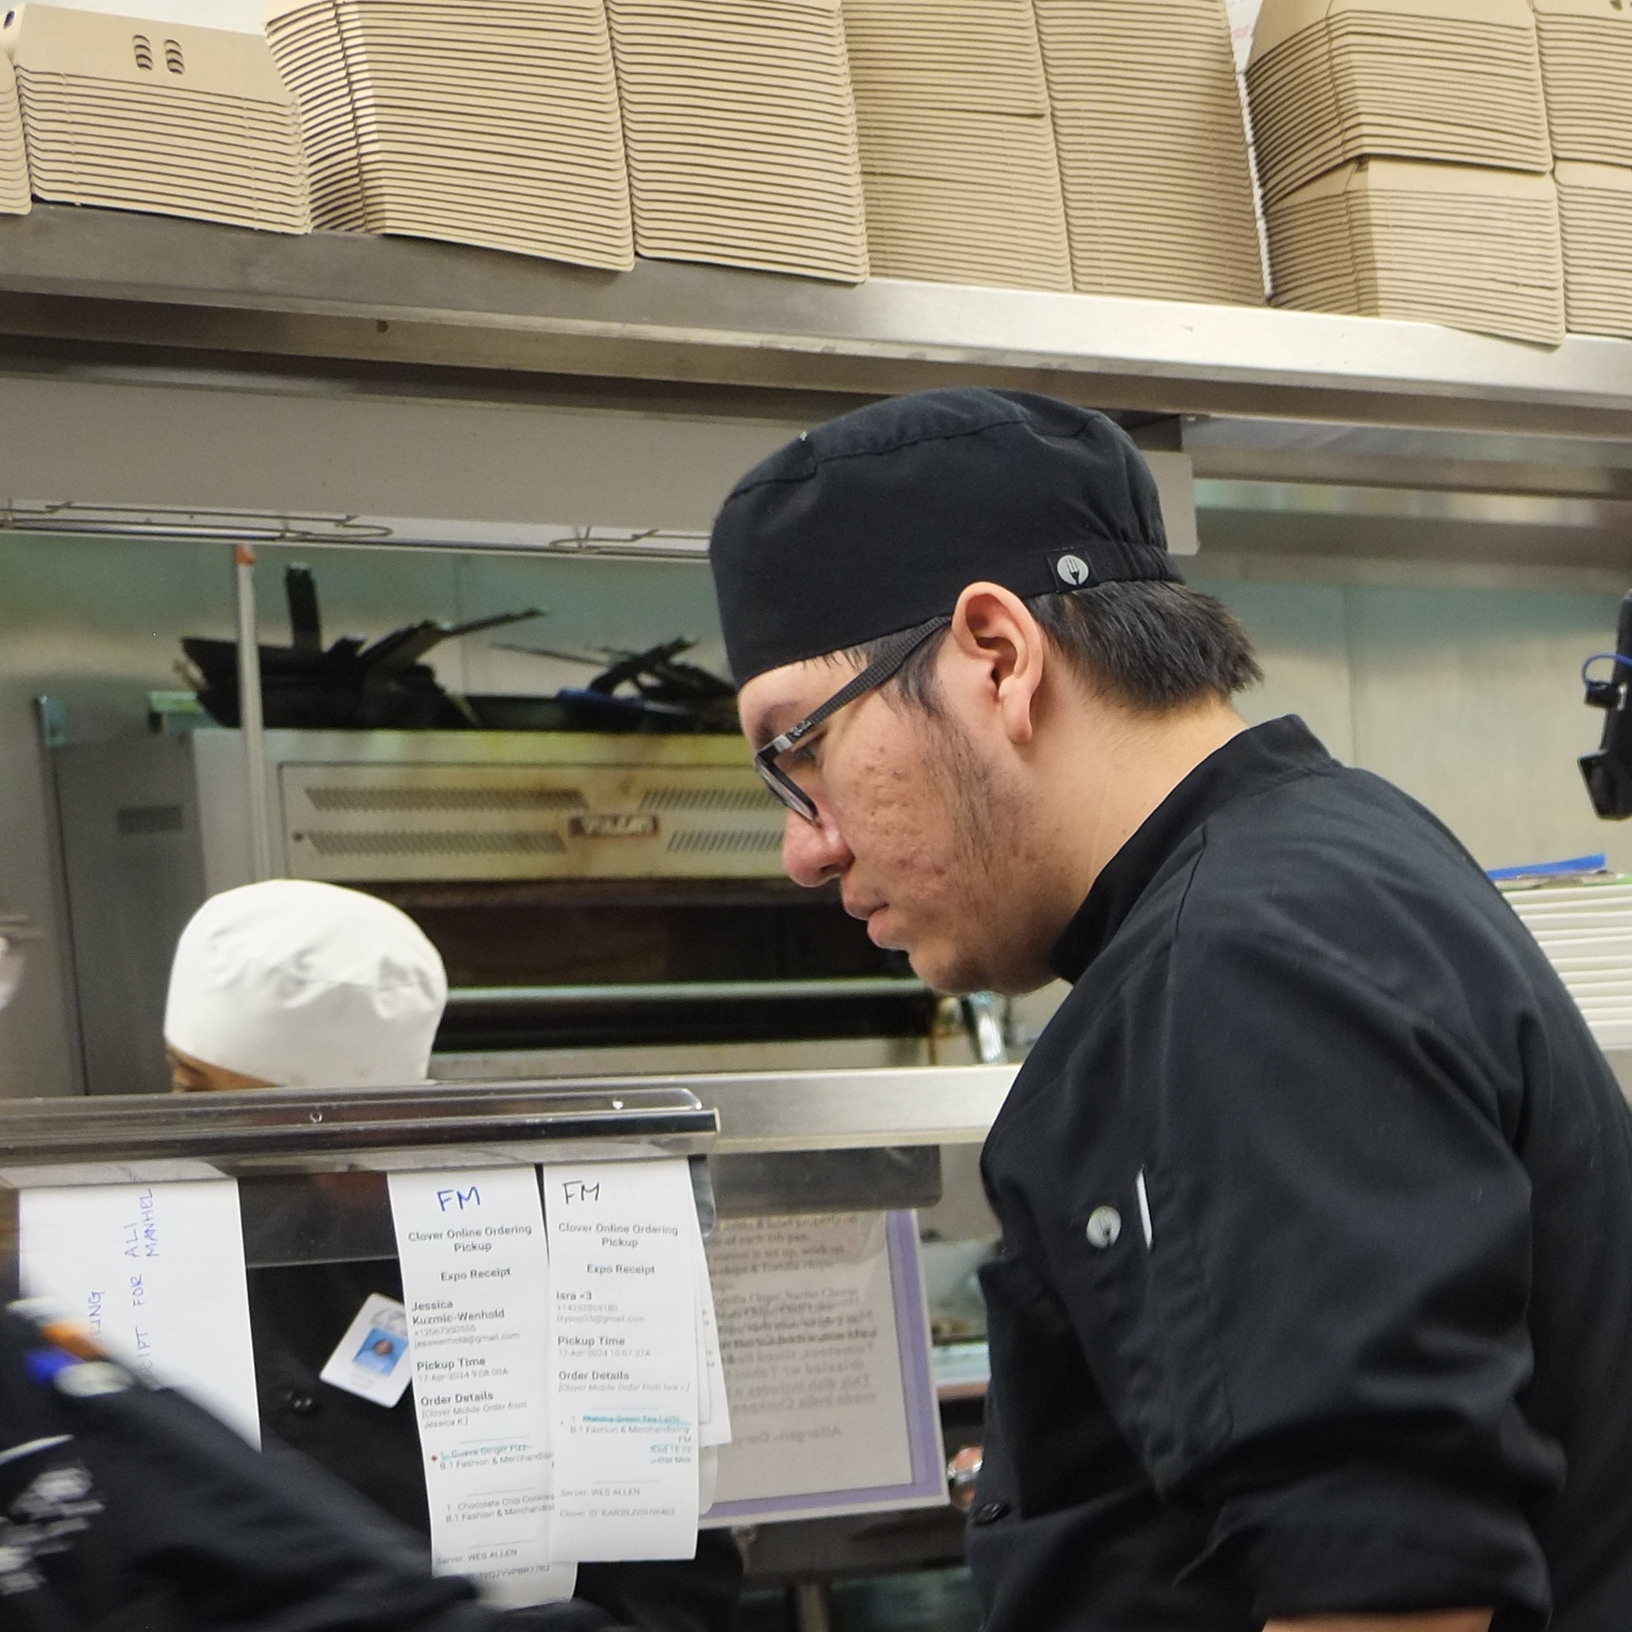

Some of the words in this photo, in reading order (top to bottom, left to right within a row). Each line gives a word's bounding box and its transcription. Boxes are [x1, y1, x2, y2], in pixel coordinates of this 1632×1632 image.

[437, 1186, 480, 1211] FM
[562, 1180, 600, 1204] FM
[408, 1231, 443, 1242] Clover
[447, 1229, 481, 1239] Online
[485, 1225, 532, 1236] Ordering
[558, 1223, 592, 1233] Clover
[595, 1223, 629, 1233] Online
[632, 1224, 678, 1236] Ordering
[124, 1223, 140, 1257] ALI
[602, 1237, 638, 1248] Pickup
[454, 1242, 492, 1252] Pickup
[441, 1271, 467, 1282] Expo
[471, 1267, 511, 1279] Receipt
[587, 1264, 613, 1275] Expo
[616, 1264, 655, 1275] Receipt
[130, 1274, 144, 1306] FOR
[556, 1291, 576, 1300] Isra
[411, 1300, 453, 1311] Jessica
[557, 1336, 595, 1347] Pickup
[599, 1336, 625, 1346] Time
[417, 1361, 455, 1371] Pickup
[459, 1358, 486, 1368] Time
[558, 1371, 588, 1380] Order
[592, 1371, 629, 1380] Details
[421, 1396, 452, 1406] Order
[455, 1391, 494, 1403] Details
[457, 1500, 500, 1511] Chocolate
